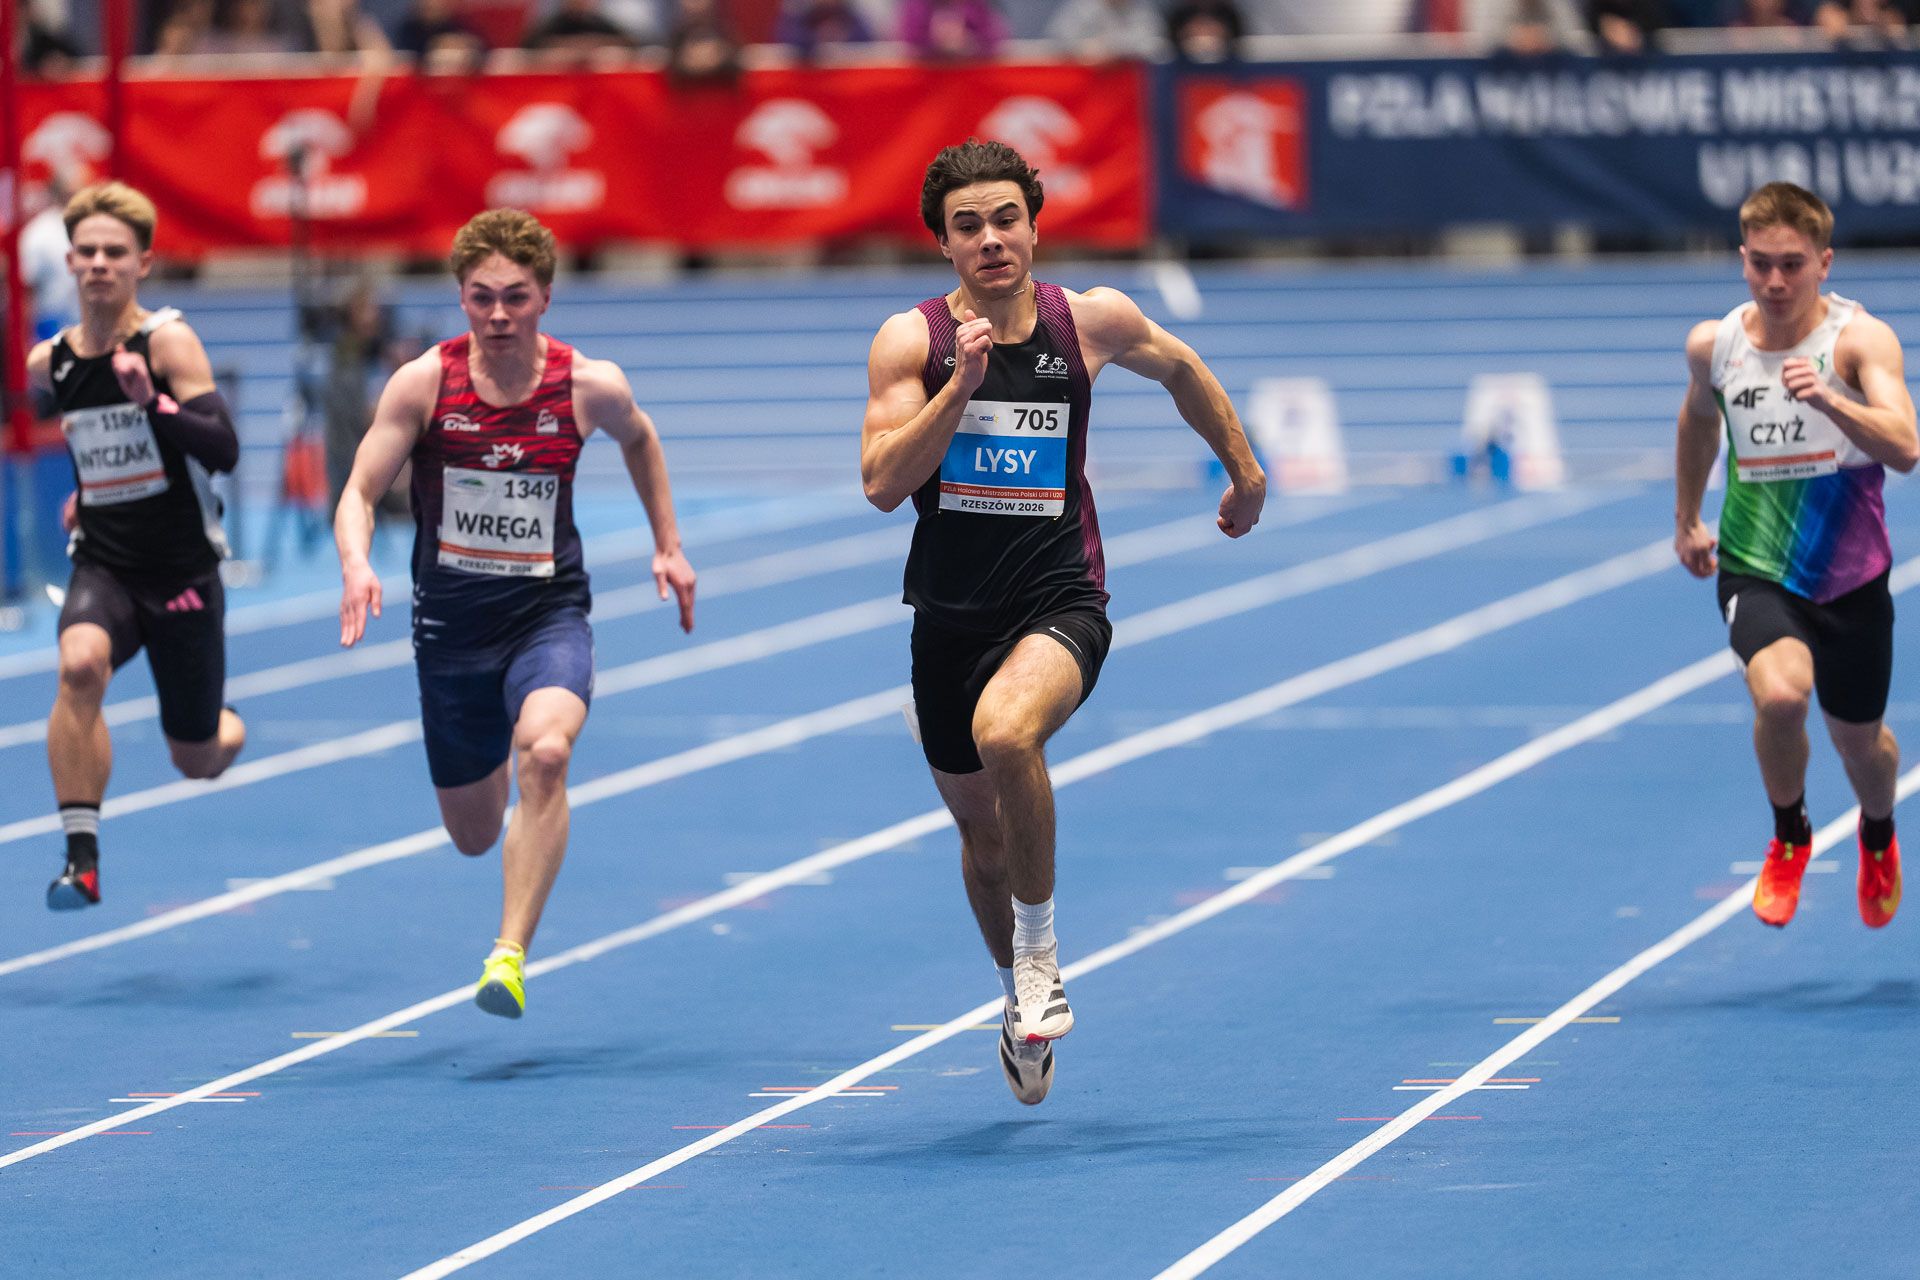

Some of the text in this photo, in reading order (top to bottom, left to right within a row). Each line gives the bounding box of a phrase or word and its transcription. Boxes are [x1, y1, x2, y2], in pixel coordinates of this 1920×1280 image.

[1732, 386, 1769, 408] 4F
[1014, 409, 1058, 431] 705
[1750, 414, 1806, 444] CZYŻ
[975, 447, 1037, 474] LYSY
[504, 479, 556, 500] 1349
[958, 487, 981, 495] Halowe
[982, 490, 1019, 498] Mistrzostwa
[961, 499, 1044, 511] RZESZÓW 2026
[455, 510, 542, 542] WRĘGA
